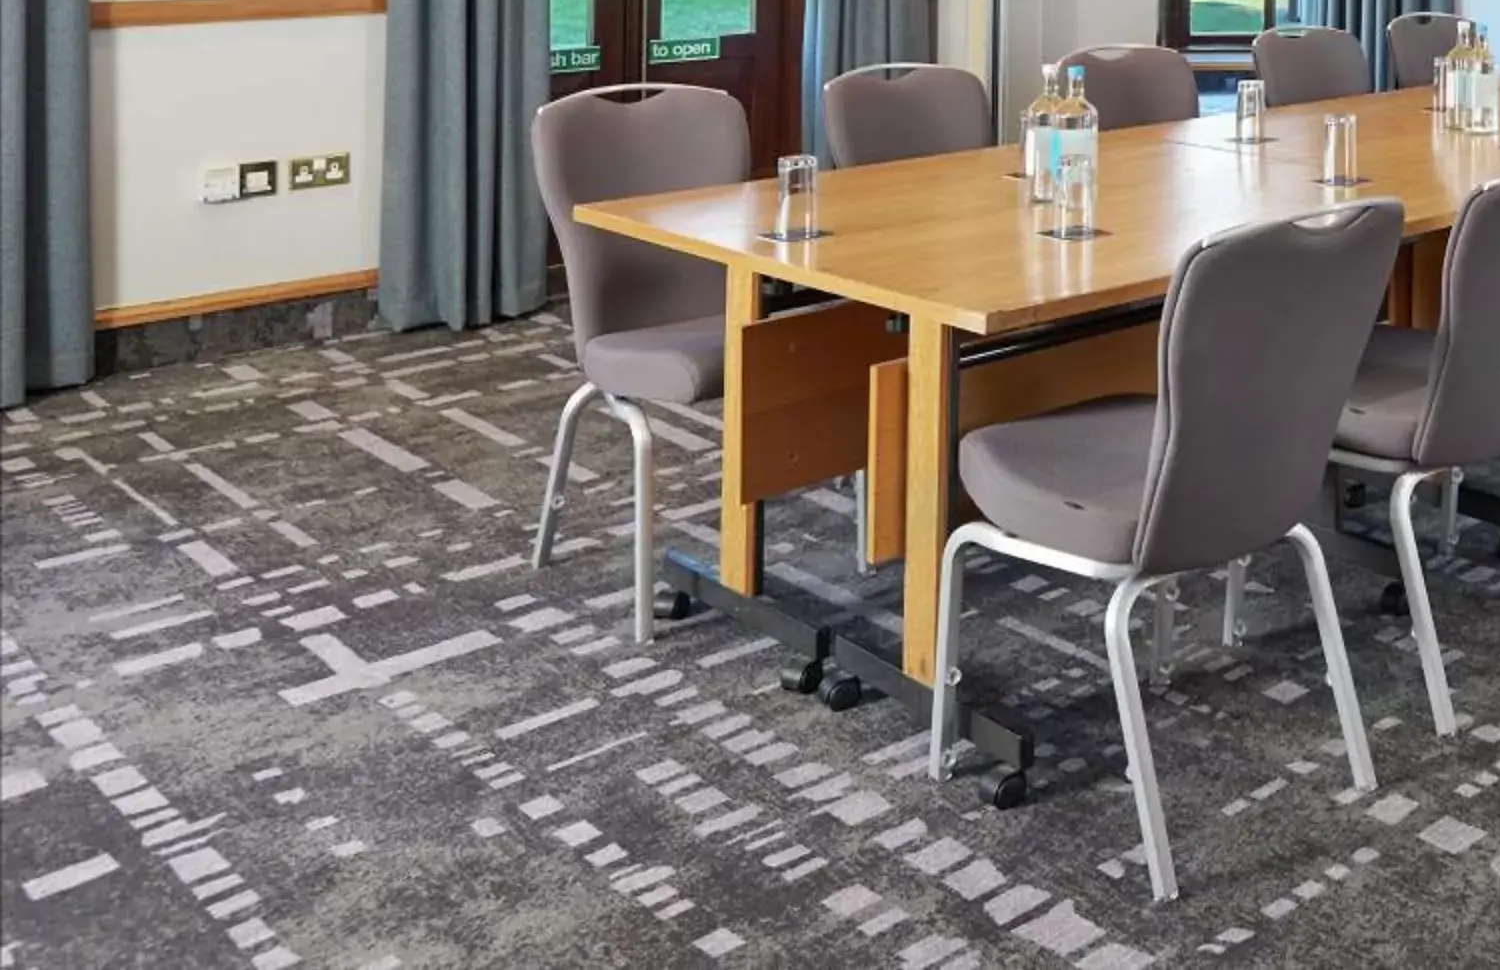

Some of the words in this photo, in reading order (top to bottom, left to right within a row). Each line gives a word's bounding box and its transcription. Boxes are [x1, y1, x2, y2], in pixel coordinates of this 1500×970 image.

[571, 50, 599, 66] bar
[653, 43, 668, 57] to
[673, 42, 711, 59] open
